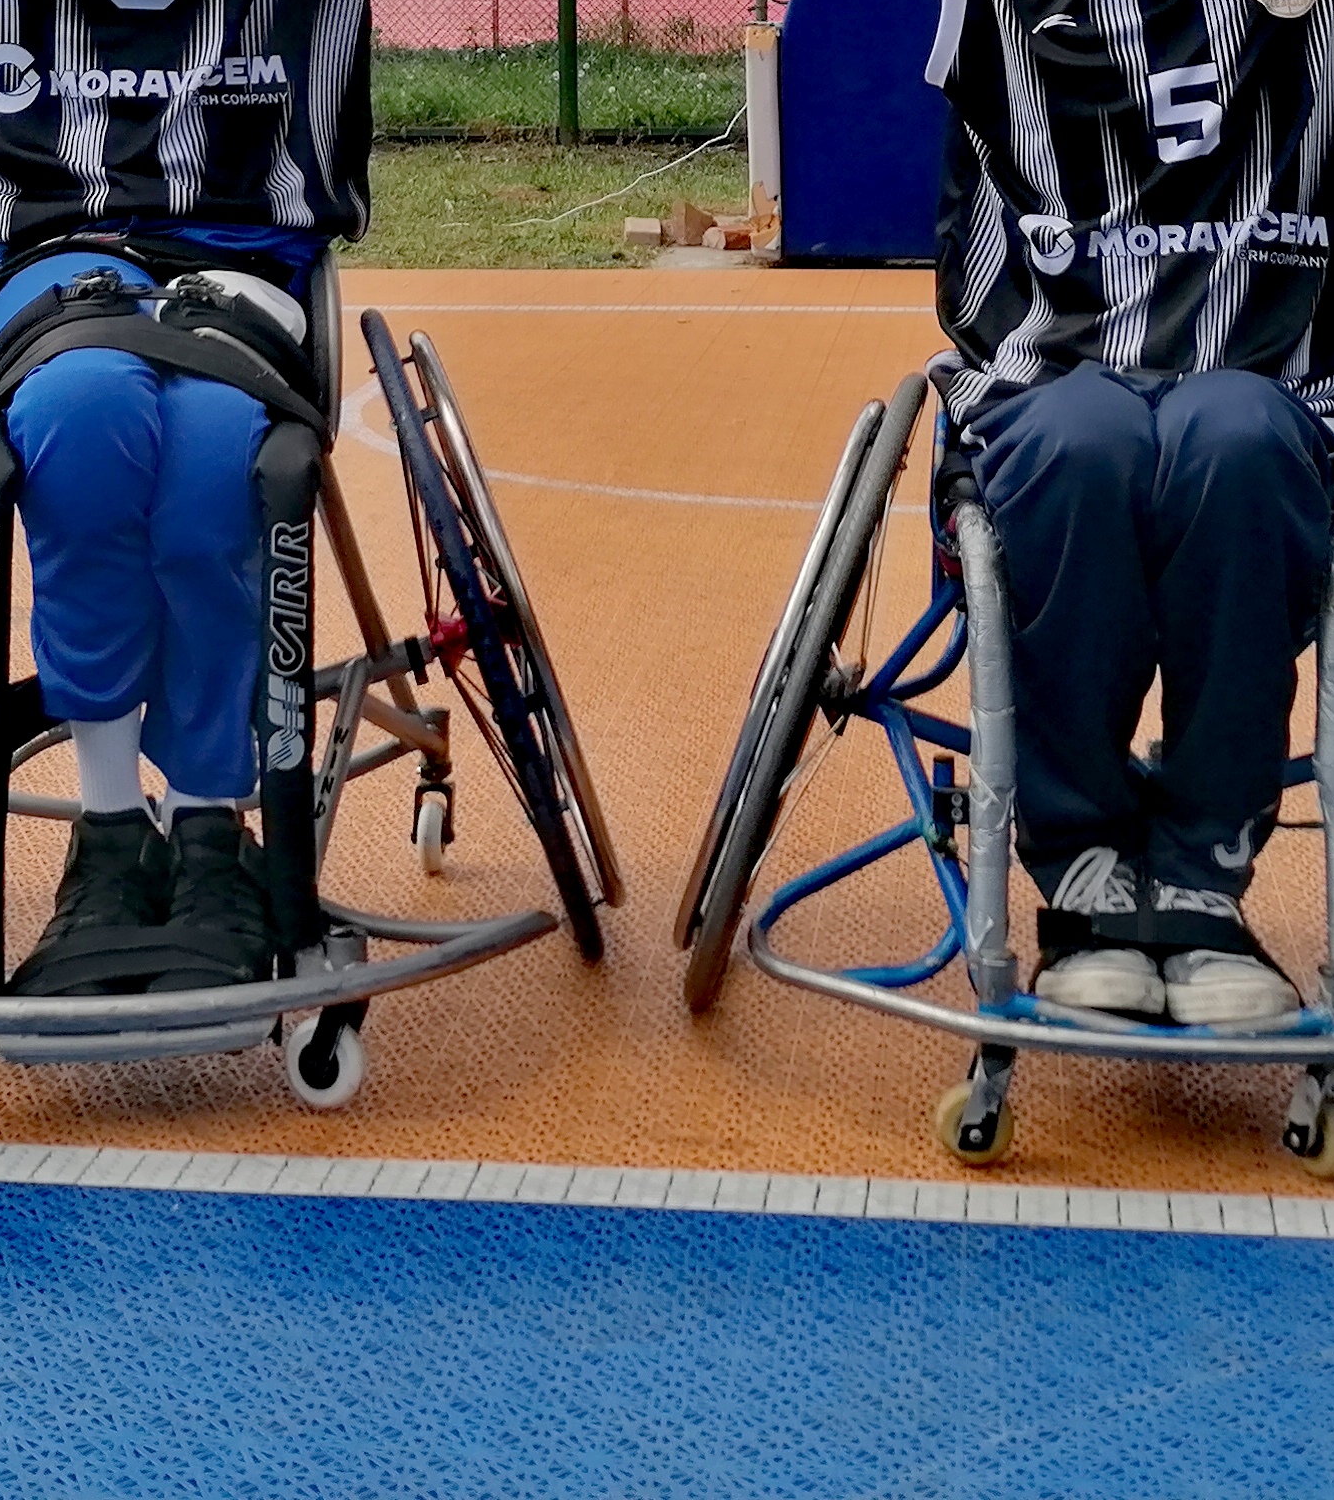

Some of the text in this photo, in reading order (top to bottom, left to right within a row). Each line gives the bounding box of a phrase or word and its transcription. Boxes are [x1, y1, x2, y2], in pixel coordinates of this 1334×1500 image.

[221, 91, 289, 106] COMPANY
[1148, 62, 1223, 163] 5
[1270, 251, 1329, 269] COMPANY
[313, 726, 349, 819] WIND
